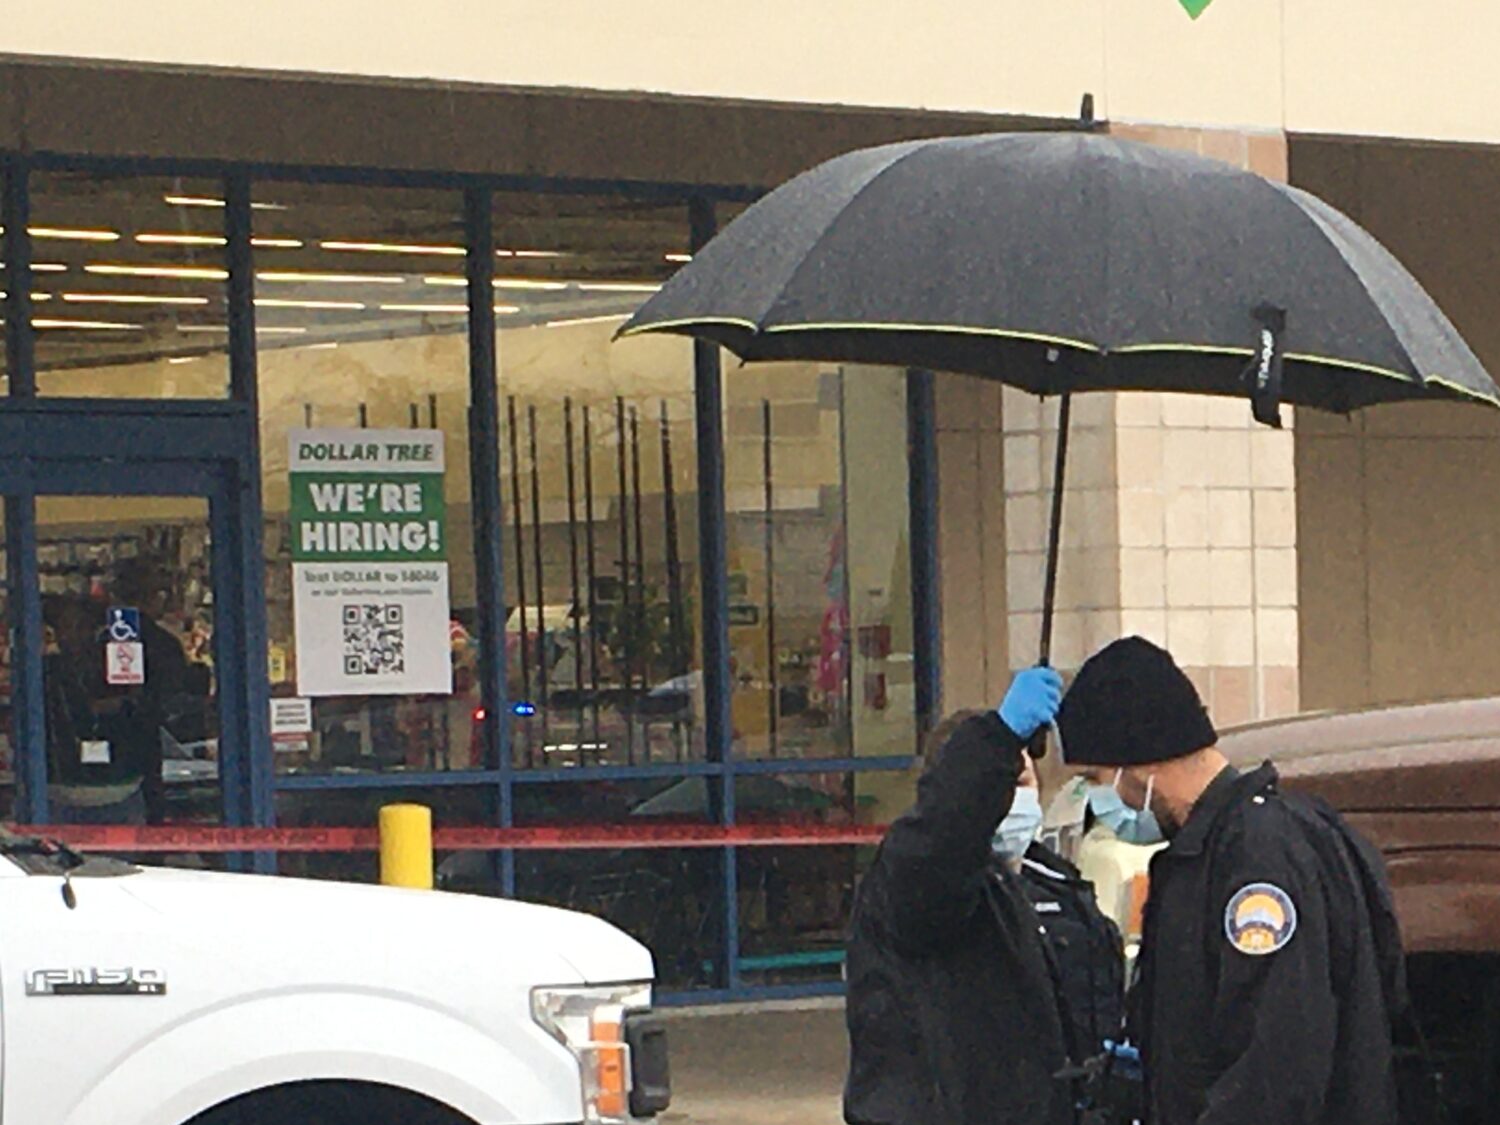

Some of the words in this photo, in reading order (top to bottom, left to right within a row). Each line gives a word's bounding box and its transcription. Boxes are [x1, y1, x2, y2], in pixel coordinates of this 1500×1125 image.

[299, 444, 379, 461] DOLLAR
[384, 444, 434, 461] TREE
[308, 482, 423, 513] WE'RE
[301, 520, 441, 552] HIRING!
